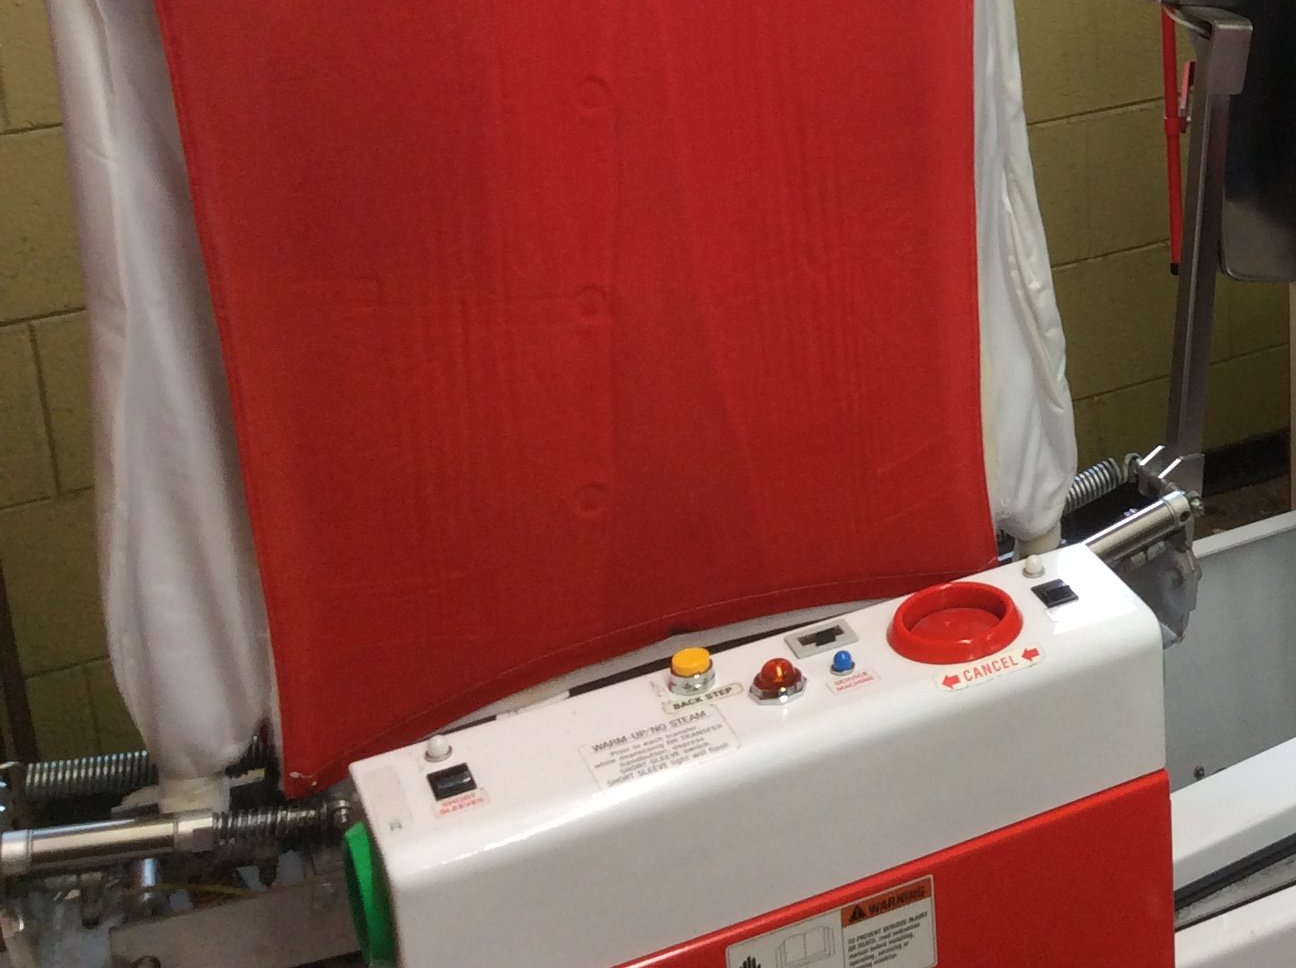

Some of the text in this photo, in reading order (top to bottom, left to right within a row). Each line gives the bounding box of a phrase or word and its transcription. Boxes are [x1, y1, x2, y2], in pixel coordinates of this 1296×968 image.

[962, 655, 1018, 682] CANCEL
[673, 687, 732, 710] BACK STEP
[591, 710, 707, 752] WARM-UP/NO STEAM
[868, 886, 926, 914] WARNING
